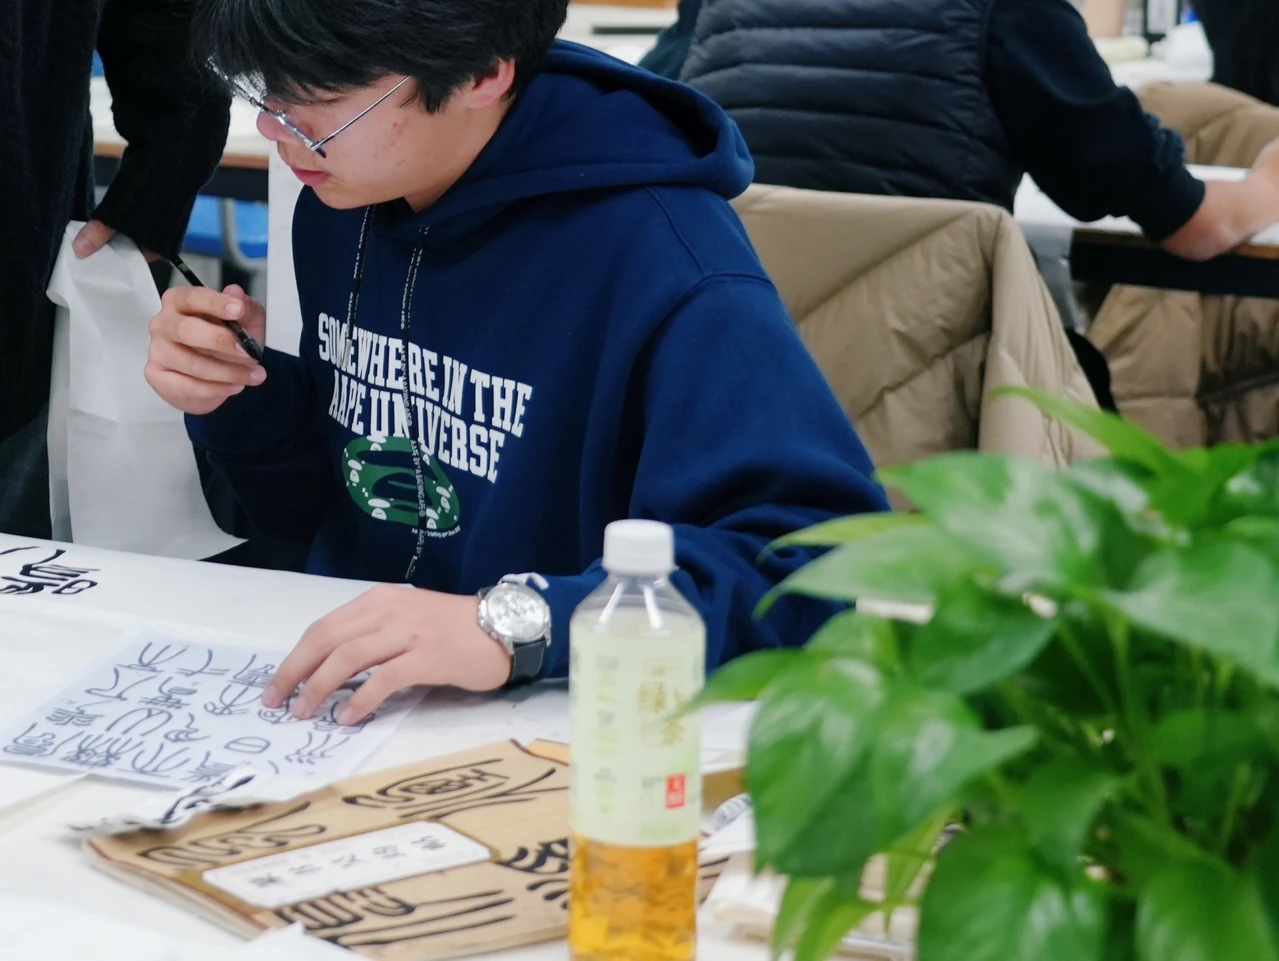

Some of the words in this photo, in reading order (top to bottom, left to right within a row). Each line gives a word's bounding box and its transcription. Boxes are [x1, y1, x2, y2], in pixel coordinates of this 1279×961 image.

[318, 312, 440, 401] SOMEWHERE
[442, 355, 468, 416] IN
[470, 369, 532, 438] THE
[328, 369, 367, 435] AAPE
[370, 388, 506, 484] UNIVERSE
